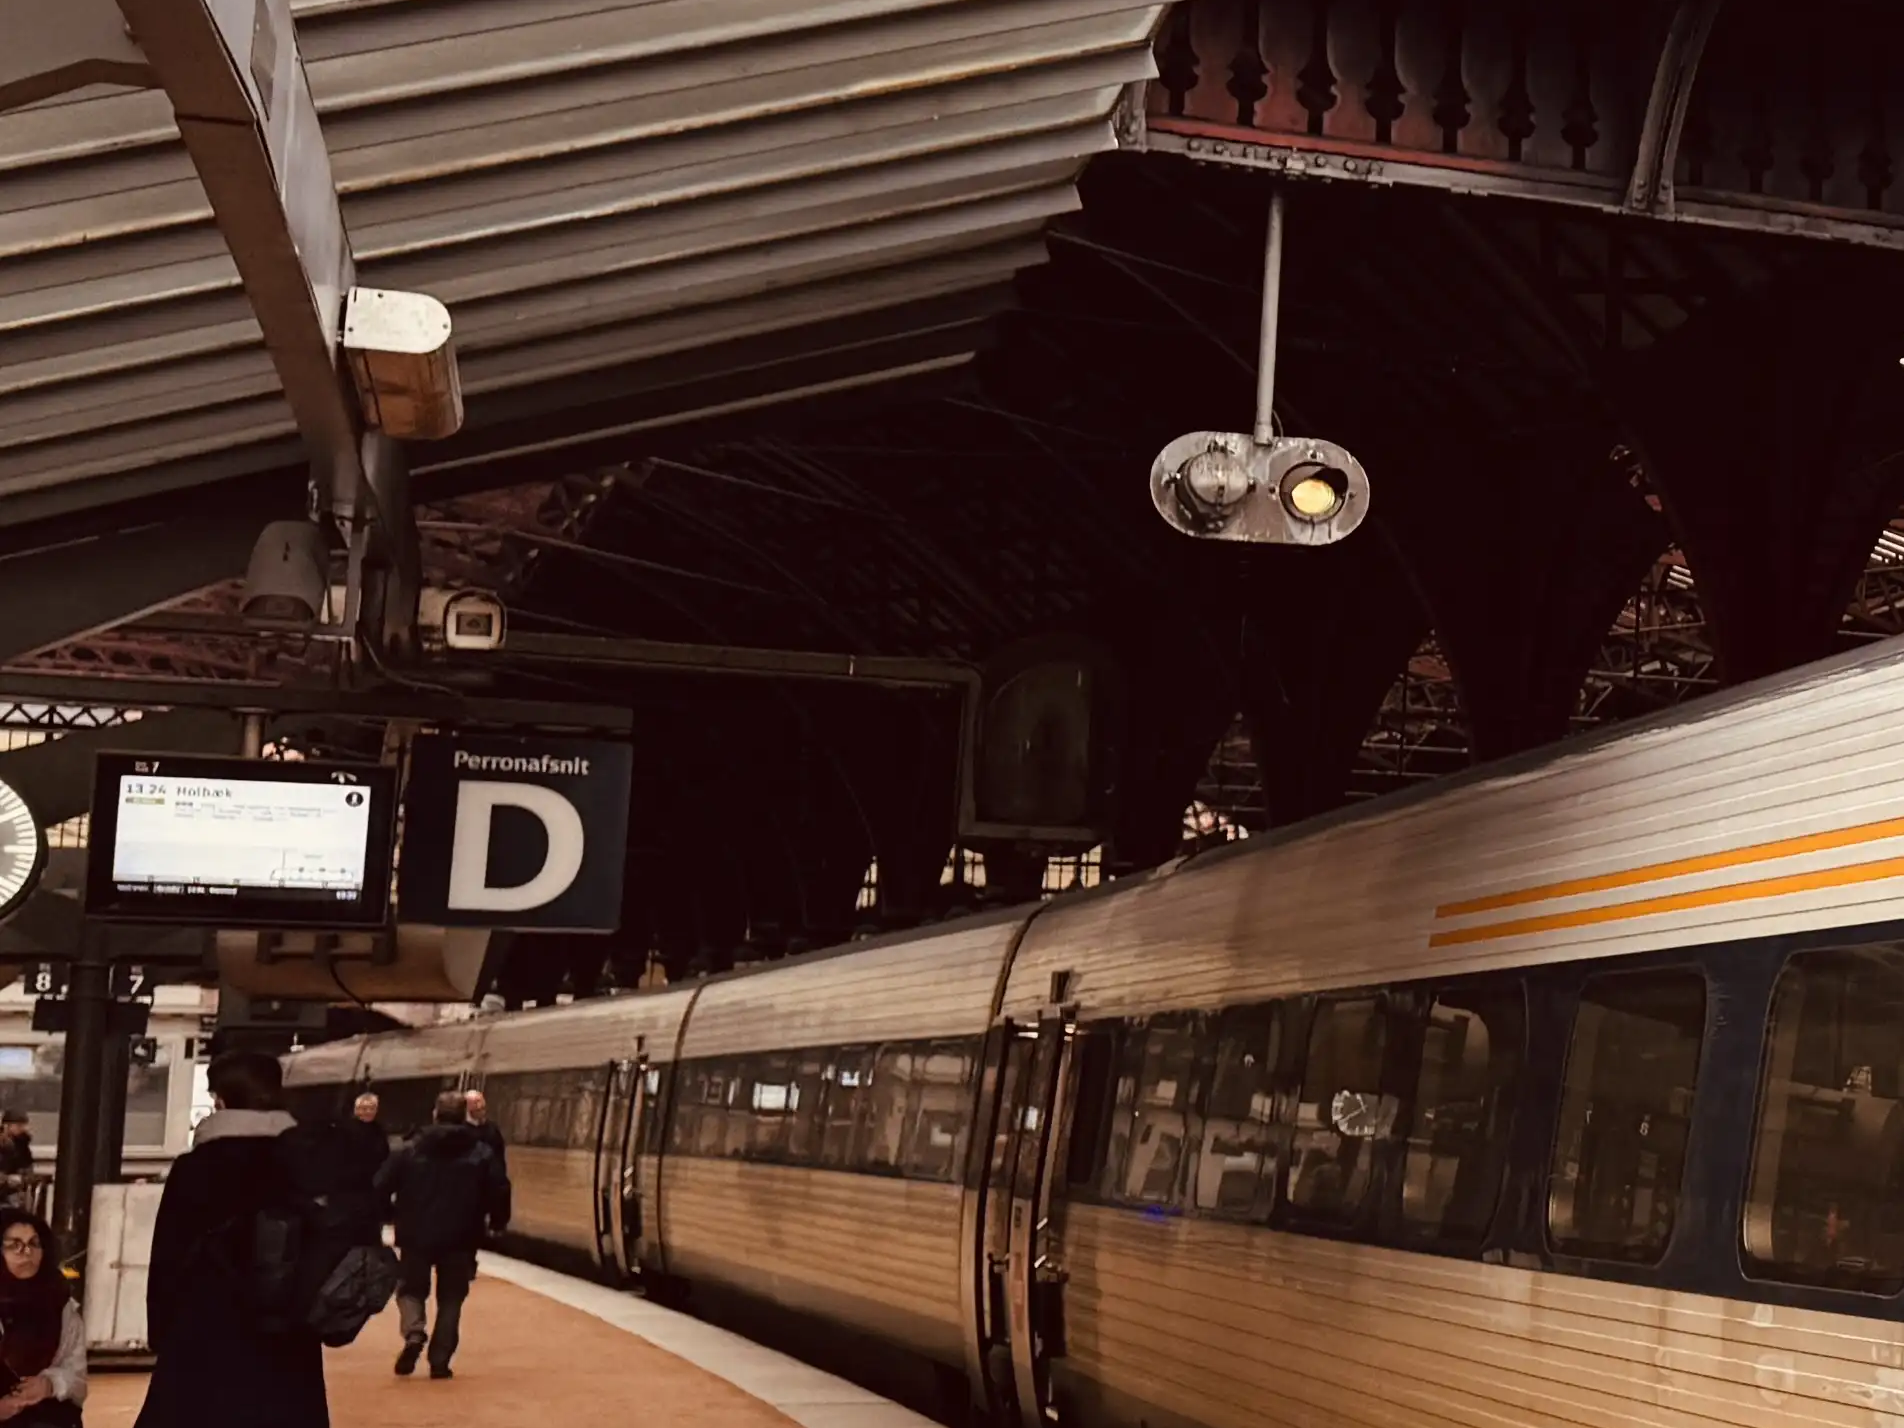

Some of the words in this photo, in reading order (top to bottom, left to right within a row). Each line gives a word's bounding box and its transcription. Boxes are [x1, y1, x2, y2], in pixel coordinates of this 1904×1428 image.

[454, 751, 590, 775] Perronafsnit
[448, 780, 584, 912] D
[35, 972, 51, 992] 8
[129, 975, 144, 995] 7
